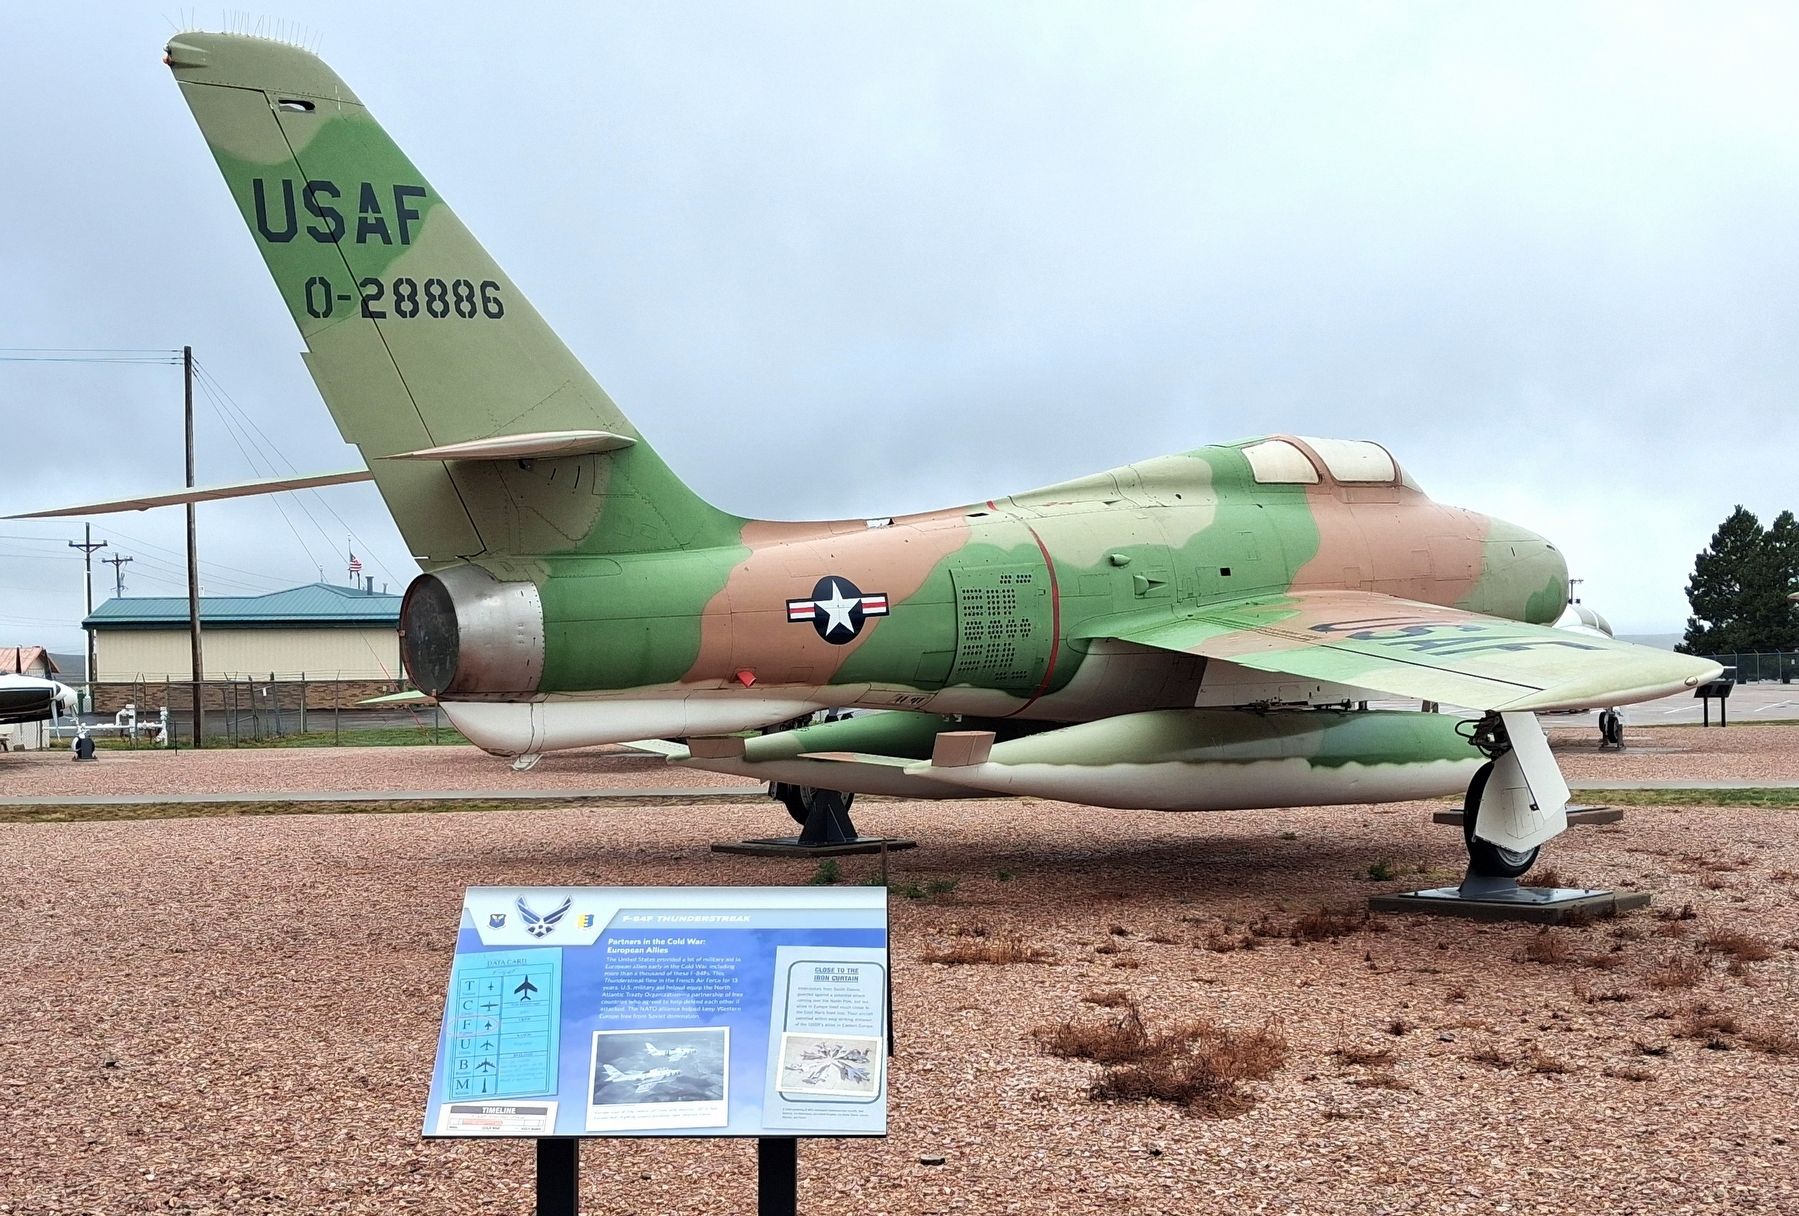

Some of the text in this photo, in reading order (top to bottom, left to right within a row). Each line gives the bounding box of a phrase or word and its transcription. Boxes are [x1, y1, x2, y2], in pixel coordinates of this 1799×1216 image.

[253, 178, 427, 245] USAF
[465, 980, 475, 990] T
[463, 1000, 473, 1010] C
[463, 1019, 472, 1029] F
[460, 1039, 471, 1049] U
[459, 1059, 468, 1070] B
[456, 1079, 470, 1090] M
